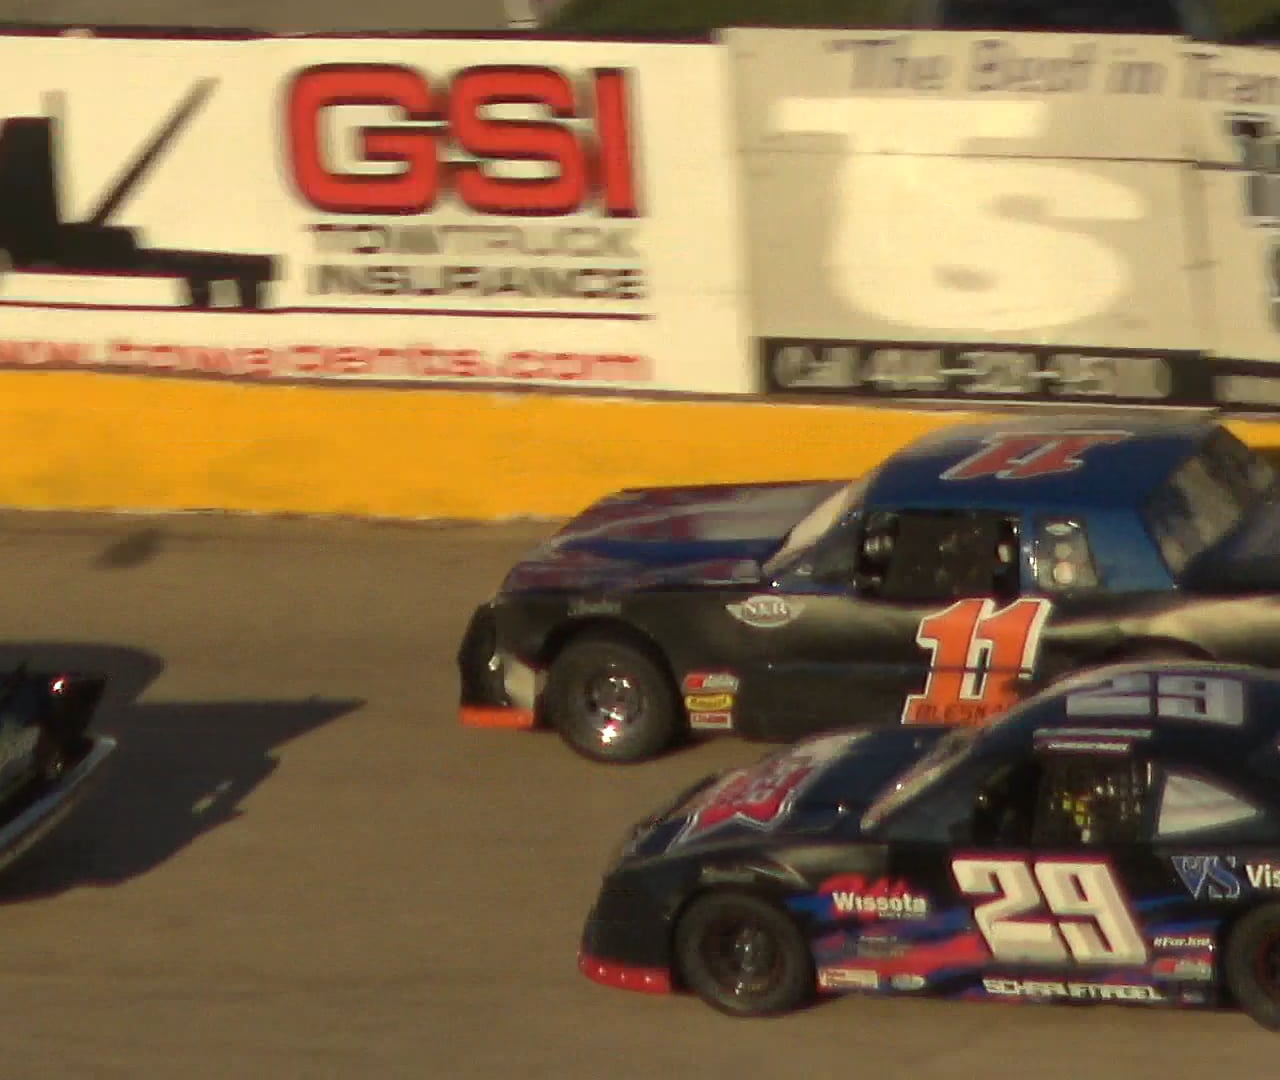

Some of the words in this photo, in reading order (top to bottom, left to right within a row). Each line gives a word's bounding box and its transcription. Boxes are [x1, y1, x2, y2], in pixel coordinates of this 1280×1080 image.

[286, 61, 640, 218] GSI
[305, 263, 646, 300] INSURANCE
[901, 597, 1053, 726] 11
[1066, 670, 1244, 726] 29
[951, 858, 1148, 966] 29
